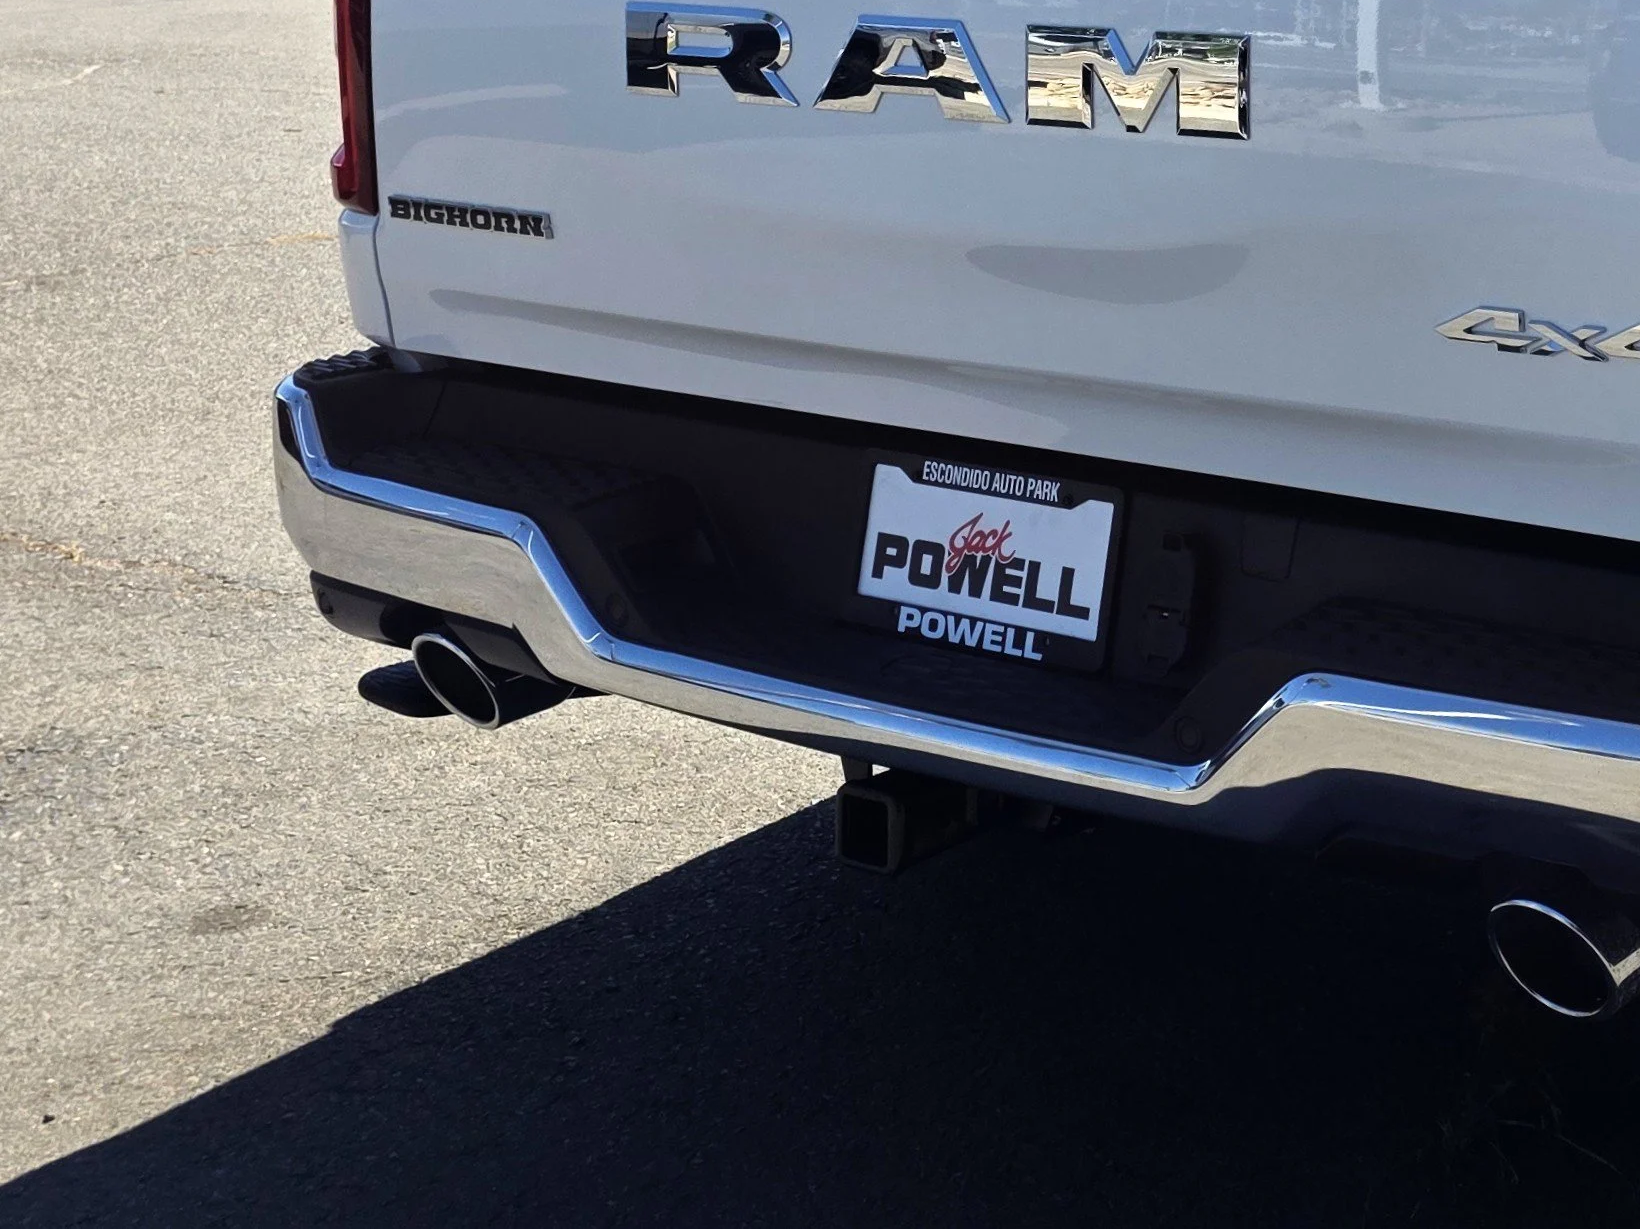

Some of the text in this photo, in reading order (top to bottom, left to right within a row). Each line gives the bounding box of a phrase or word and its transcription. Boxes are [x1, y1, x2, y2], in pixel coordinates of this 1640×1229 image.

[625, 0, 1252, 141] RAM
[388, 194, 554, 239] BIGHORN
[922, 461, 1061, 503] ESCONDIDO AUTO PARK
[944, 511, 1017, 576] Jack
[870, 531, 1091, 621] POWELL
[896, 605, 1043, 662] POWELL
